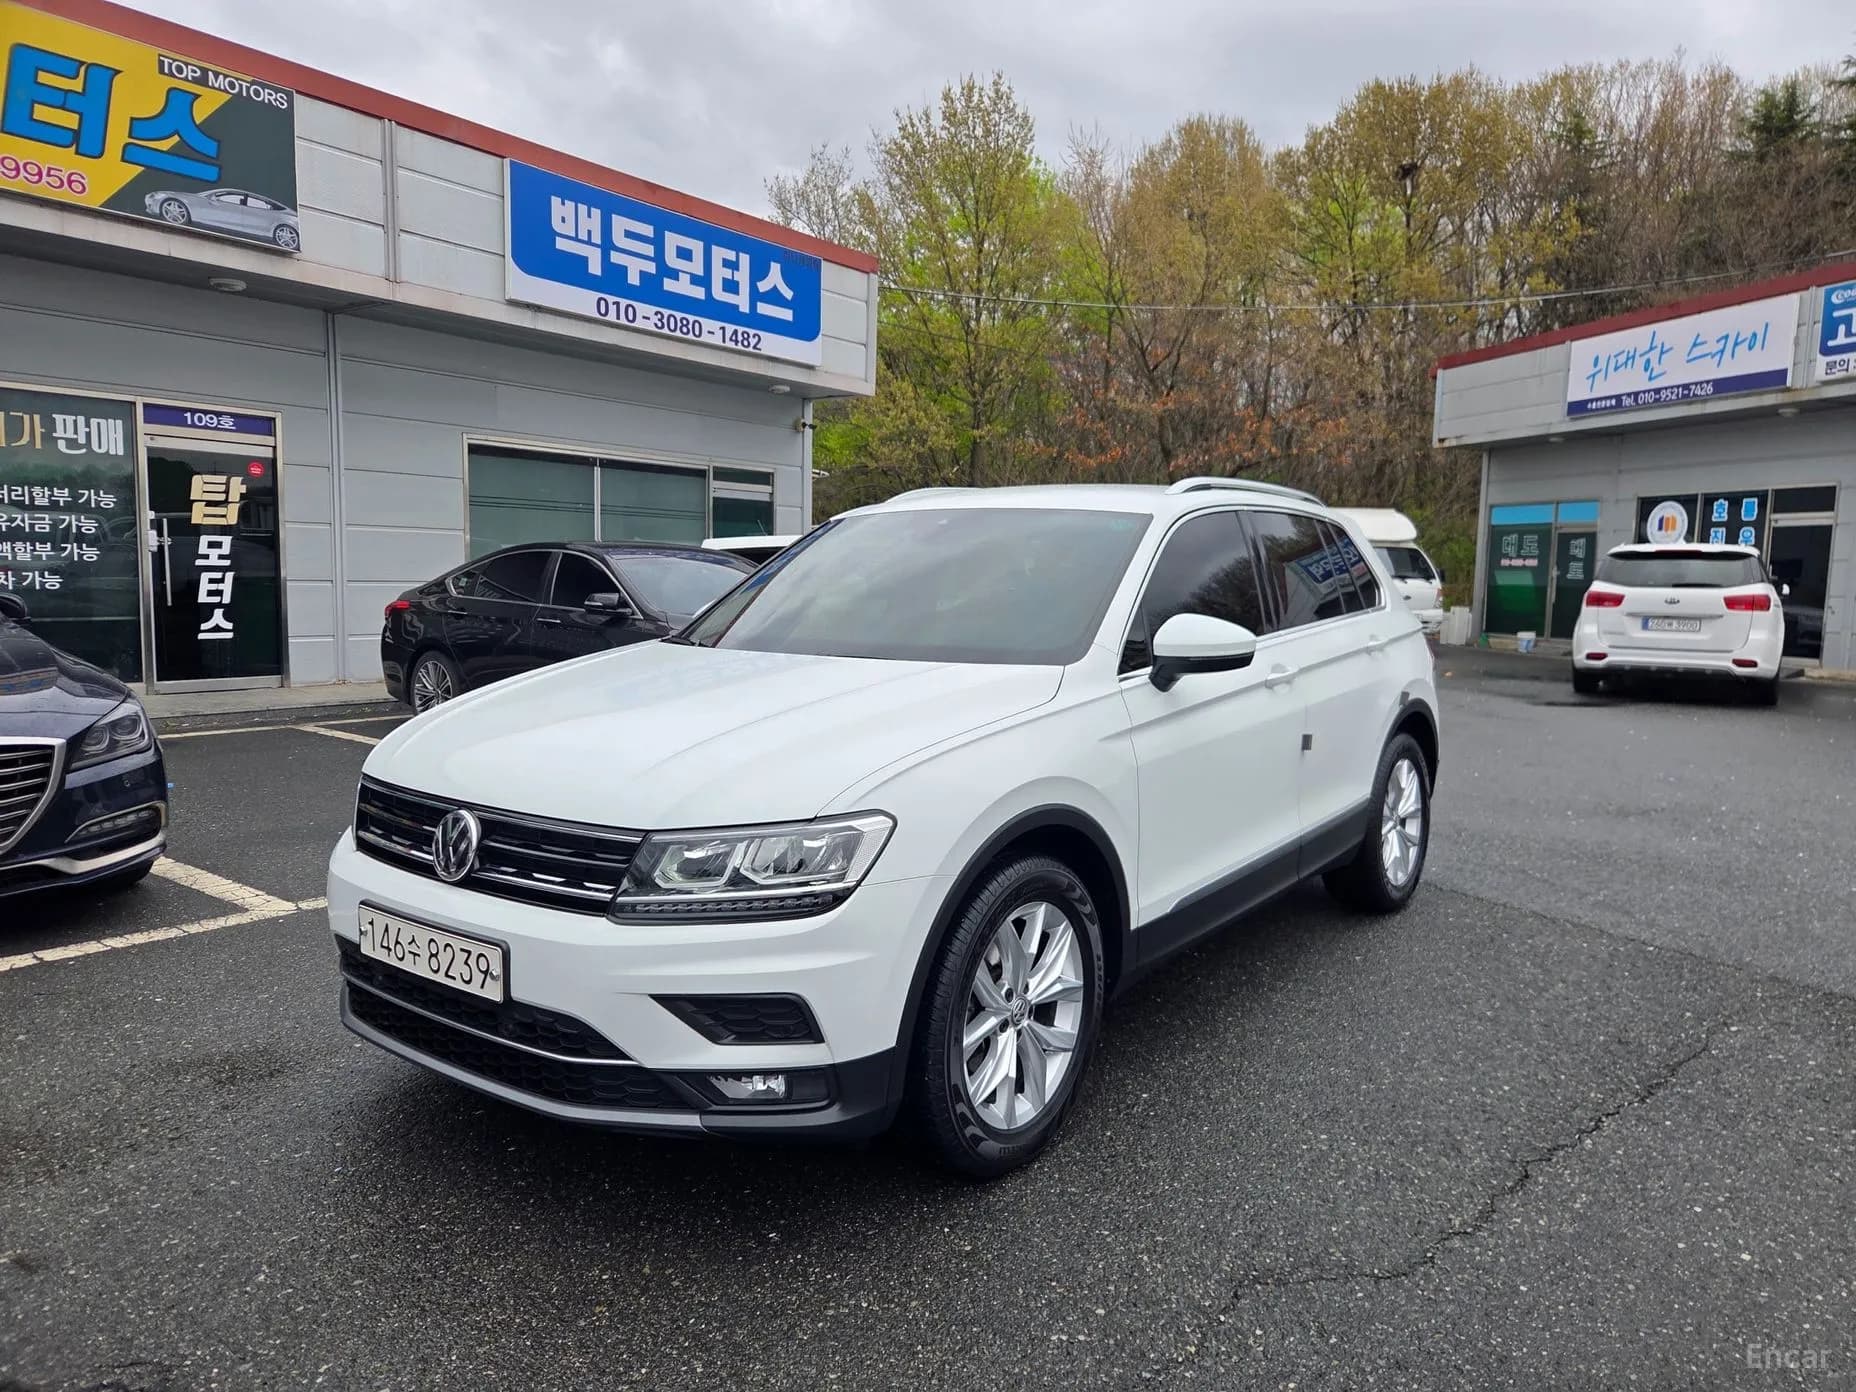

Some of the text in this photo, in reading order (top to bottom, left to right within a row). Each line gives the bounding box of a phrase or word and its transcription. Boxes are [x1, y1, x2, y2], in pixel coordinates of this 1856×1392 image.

[159, 55, 288, 109] TOP MOTORS
[1, 43, 221, 184] 터스
[0, 155, 88, 195] 9956
[551, 195, 794, 322] 백두모터스
[595, 296, 763, 351] 010-3080-1482
[1585, 322, 1770, 392] 위대한 스카이
[1638, 382, 1714, 405] 010-9521-7426
[52, 413, 124, 456] 판매
[183, 412, 236, 430] 109호
[77, 488, 118, 509] 가능
[58, 514, 99, 534] 가능
[60, 542, 101, 562] 가능
[22, 570, 64, 590] 가능
